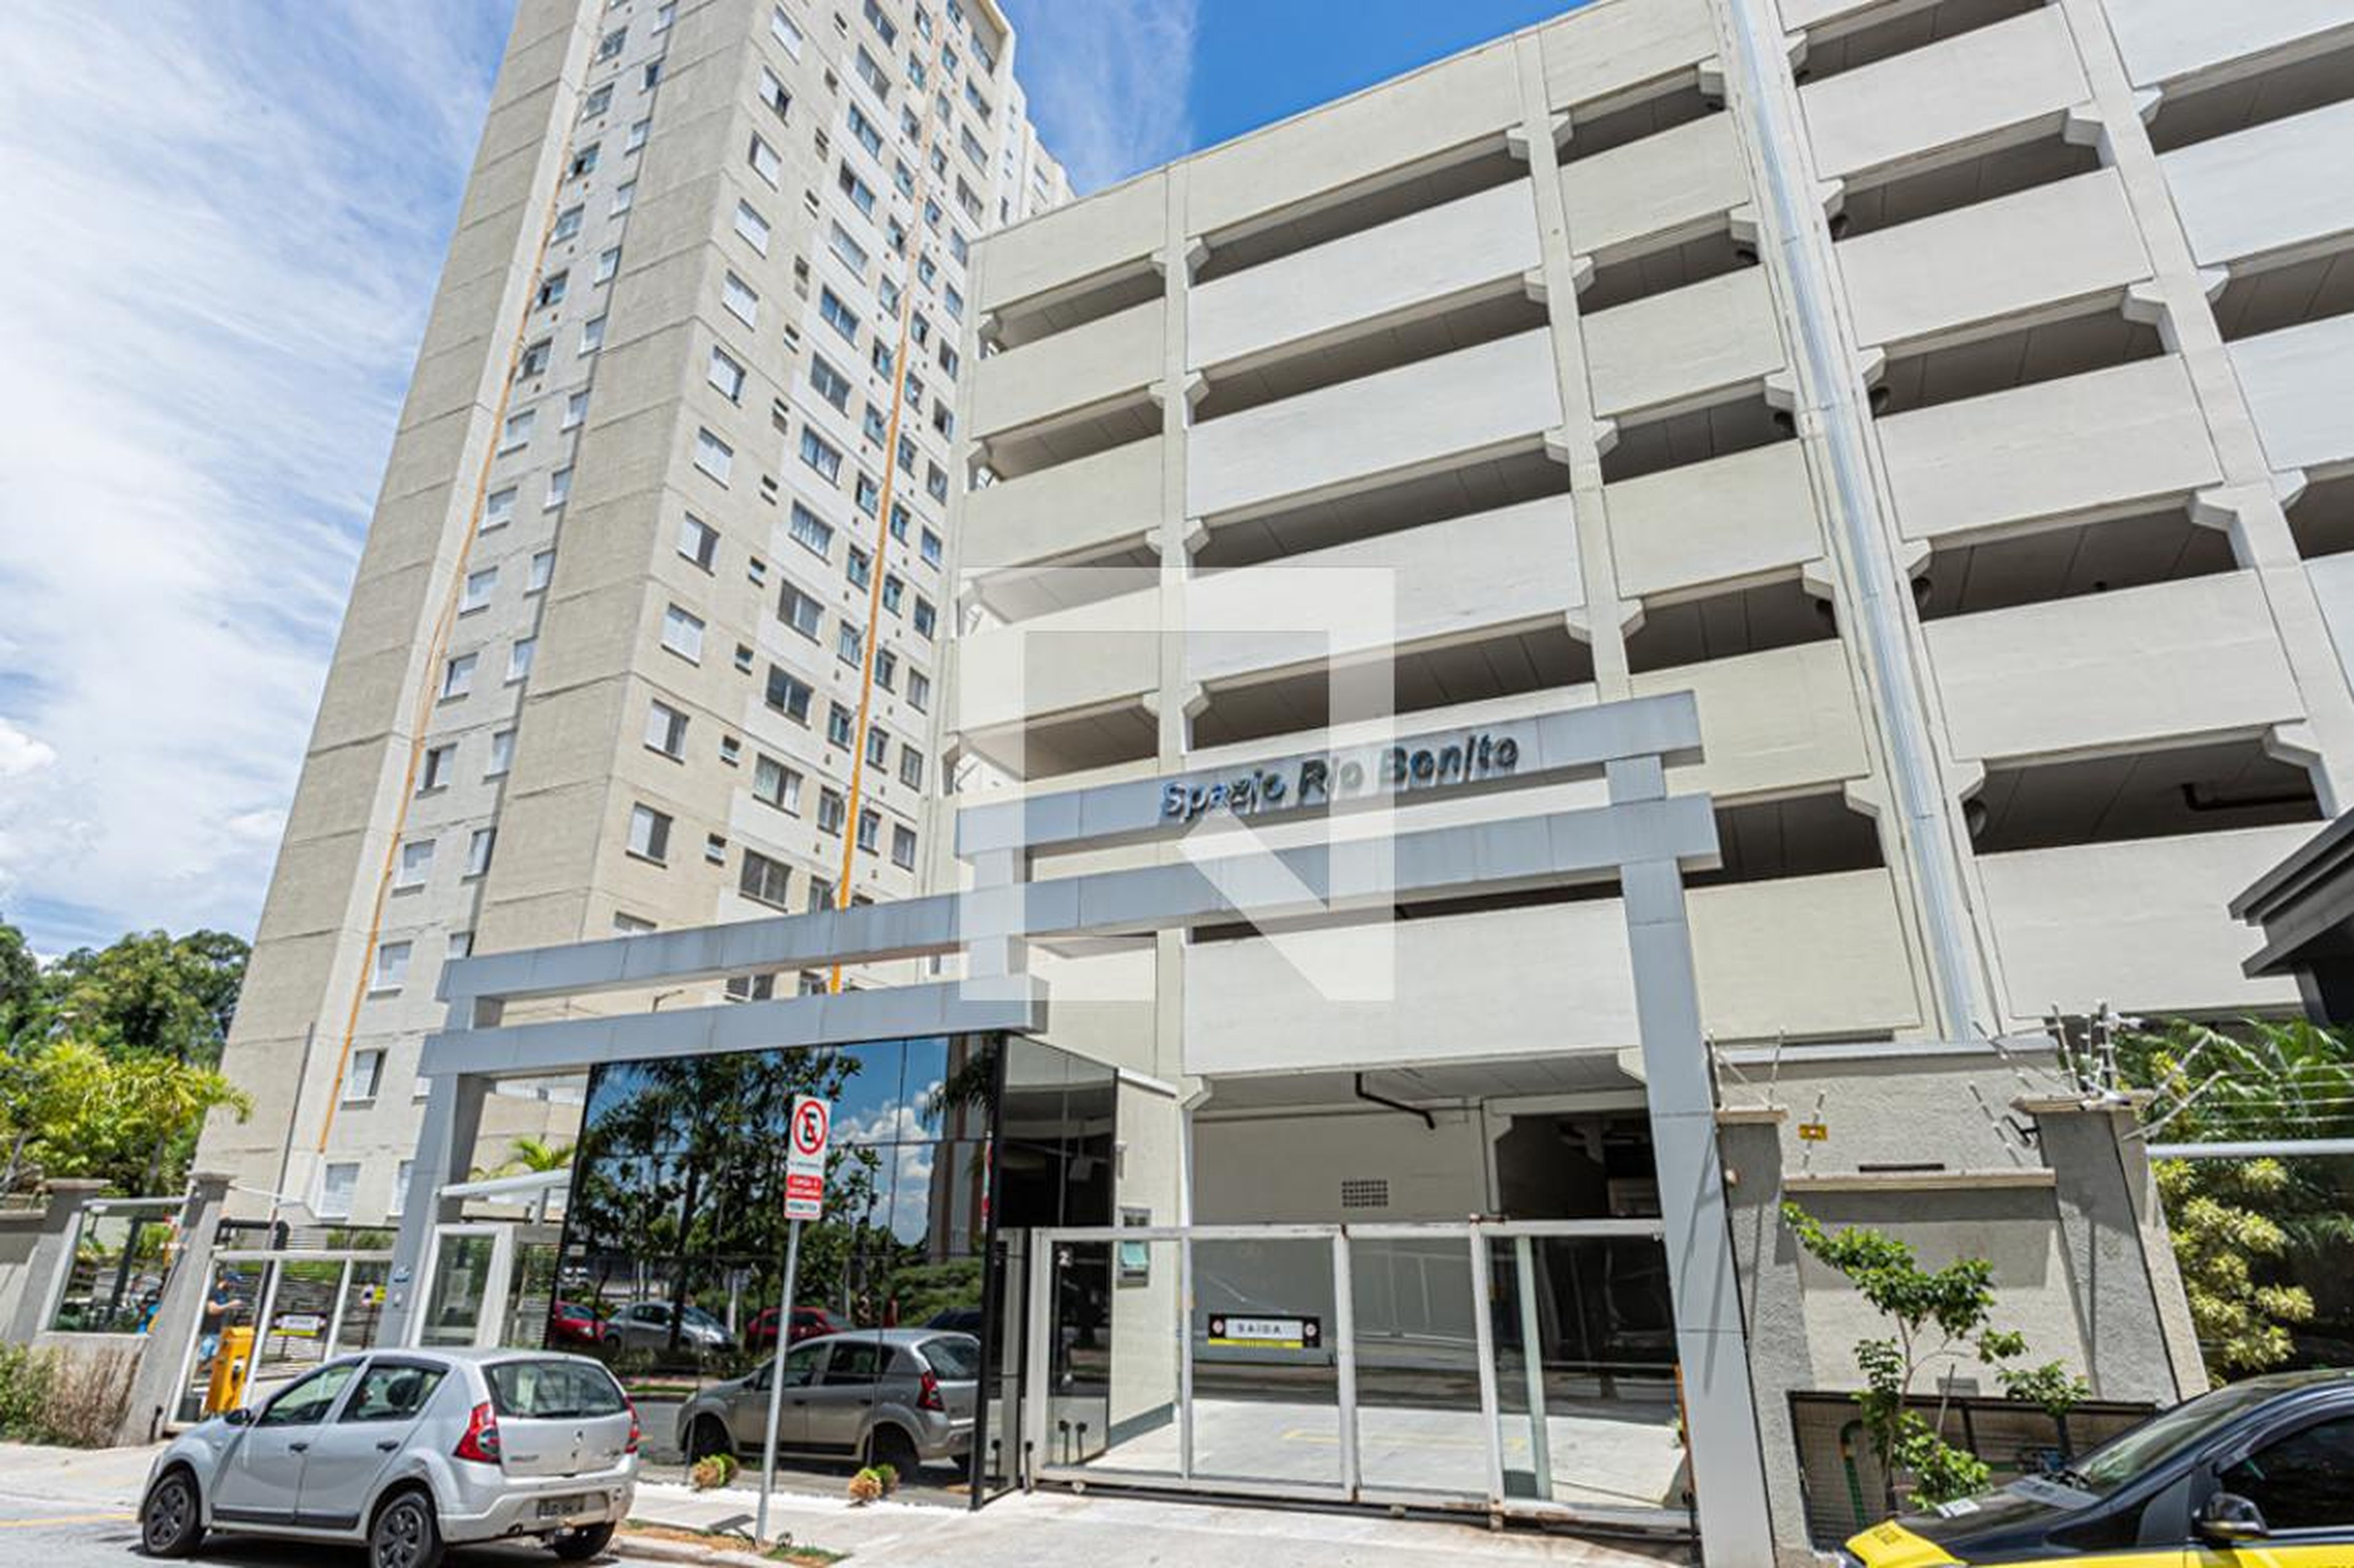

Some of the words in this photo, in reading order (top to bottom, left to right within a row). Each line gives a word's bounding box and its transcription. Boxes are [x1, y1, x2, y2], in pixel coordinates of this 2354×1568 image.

[1165, 769, 1286, 820] Spazio
[1298, 757, 1365, 798] Rio
[1379, 734, 1518, 786] Bonito
